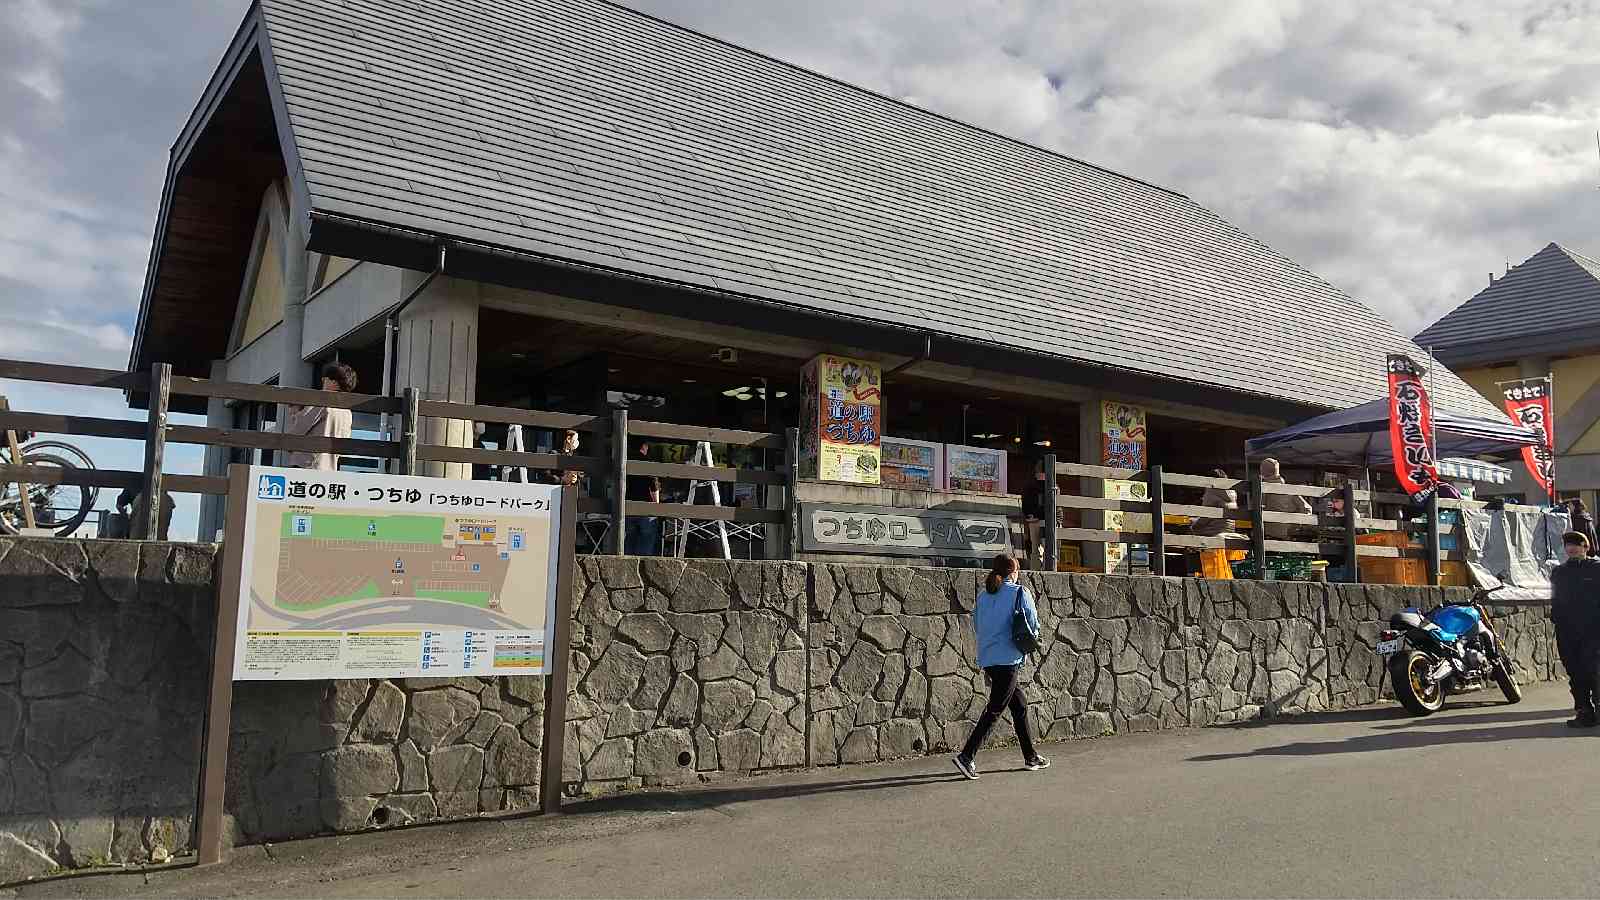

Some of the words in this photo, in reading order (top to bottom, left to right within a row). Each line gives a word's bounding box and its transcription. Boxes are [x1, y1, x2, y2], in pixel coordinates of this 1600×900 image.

[828, 400, 874, 424] 道の駅
[287, 480, 422, 504] 道の駅・つちゆ
